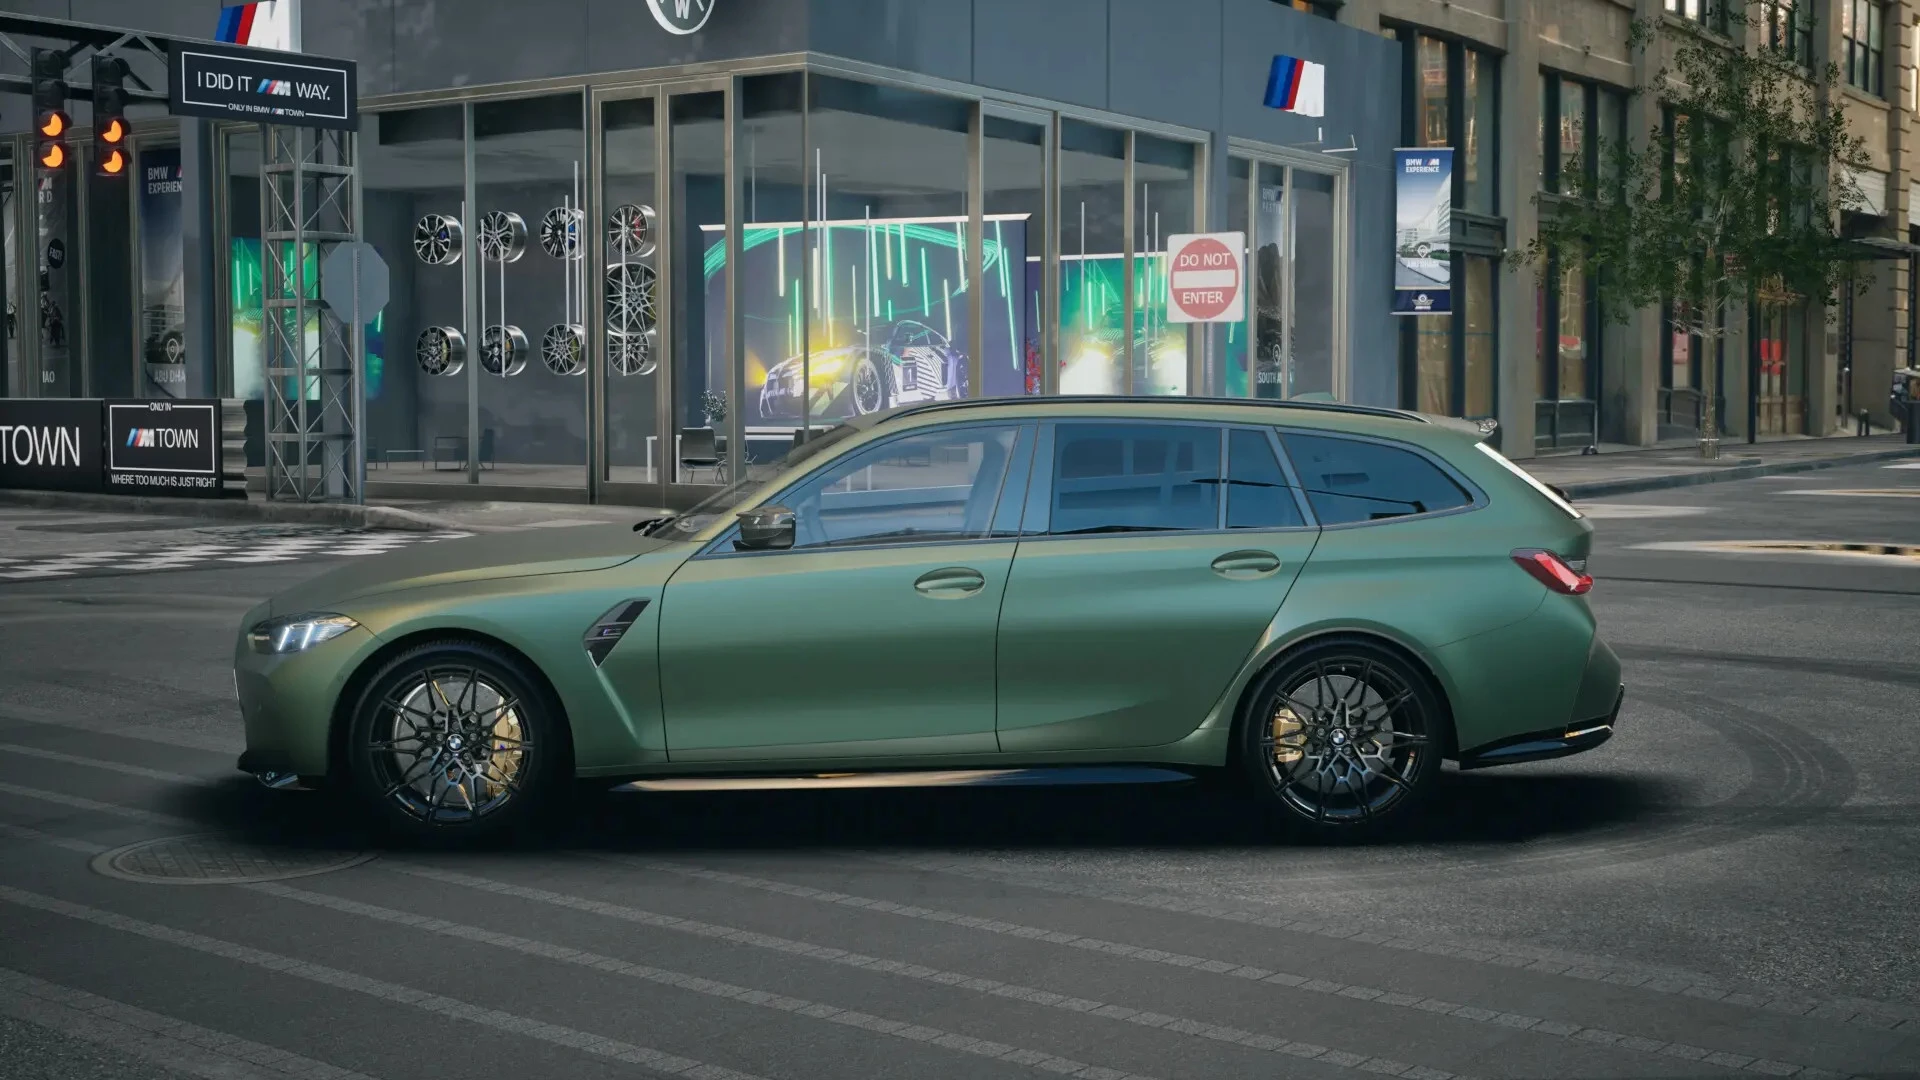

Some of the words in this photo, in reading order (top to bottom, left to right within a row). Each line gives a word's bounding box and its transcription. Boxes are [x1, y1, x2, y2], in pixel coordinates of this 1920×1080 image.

[197, 71, 201, 87] I
[205, 72, 234, 90] DID
[237, 75, 253, 92] IT
[295, 81, 331, 101] WAY.
[228, 102, 246, 113] ONLY
[245, 104, 253, 113] IN
[253, 105, 271, 114] BMW
[285, 108, 305, 117] TOWN
[1405, 158, 1423, 166] BMW
[147, 165, 169, 180] BMW
[1180, 253, 1199, 267] DO
[1203, 252, 1231, 266] NOT
[1182, 291, 1224, 305] ENTER
[154, 369, 169, 383] ABU
[150, 402, 165, 412] ONLY
[165, 402, 172, 412] IN
[0, 424, 81, 467] TOWN
[156, 428, 199, 449] TOWN
[111, 474, 135, 486] WHERE
[135, 475, 149, 486] TOO
[149, 475, 170, 487] MUCH
[170, 476, 177, 487] IS
[177, 476, 196, 488] JUST
[195, 476, 217, 489] RIGHT
